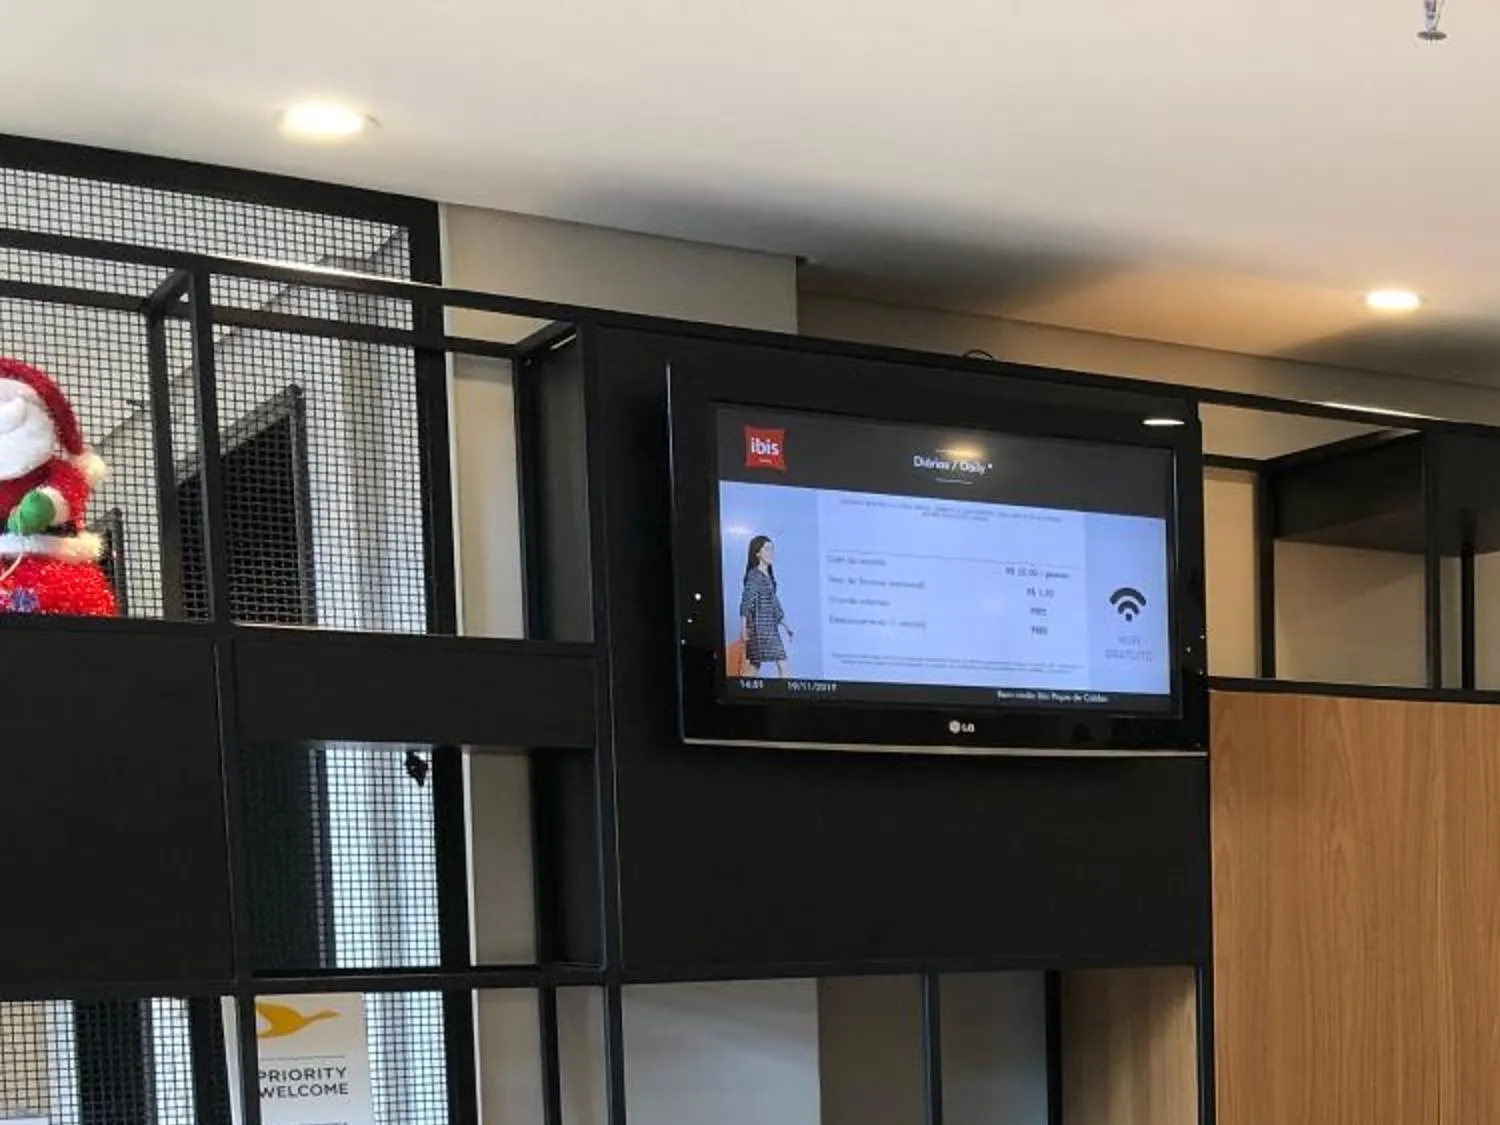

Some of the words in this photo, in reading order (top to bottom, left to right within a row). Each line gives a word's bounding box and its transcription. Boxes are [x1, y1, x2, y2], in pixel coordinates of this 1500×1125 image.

[751, 437, 779, 455] ibis
[962, 723, 975, 732] LG
[258, 1066, 347, 1082] PRIORITY
[259, 1083, 349, 1098] WELCOME
